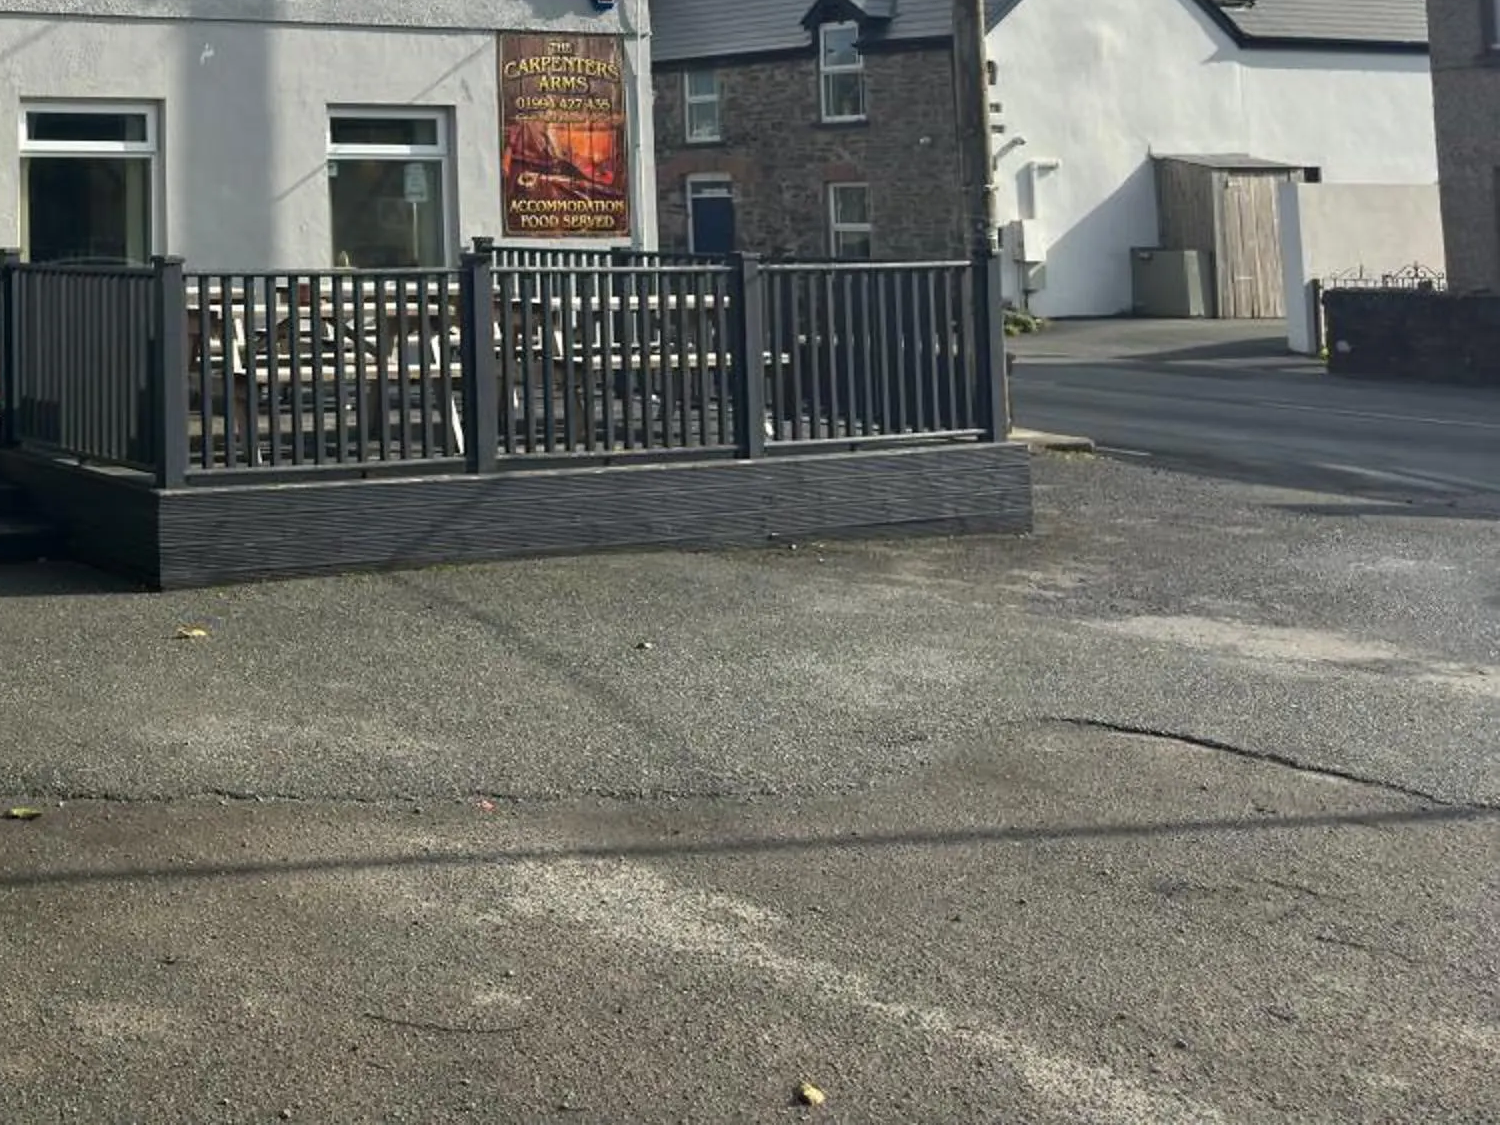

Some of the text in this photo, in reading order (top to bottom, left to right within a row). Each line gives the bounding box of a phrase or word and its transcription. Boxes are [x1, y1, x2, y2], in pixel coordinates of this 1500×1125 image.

[504, 56, 620, 78] CARPENTERS
[538, 75, 590, 92] ARMS
[509, 199, 625, 212] ACCOMMODATION
[521, 214, 615, 227] FOOD SERVED
